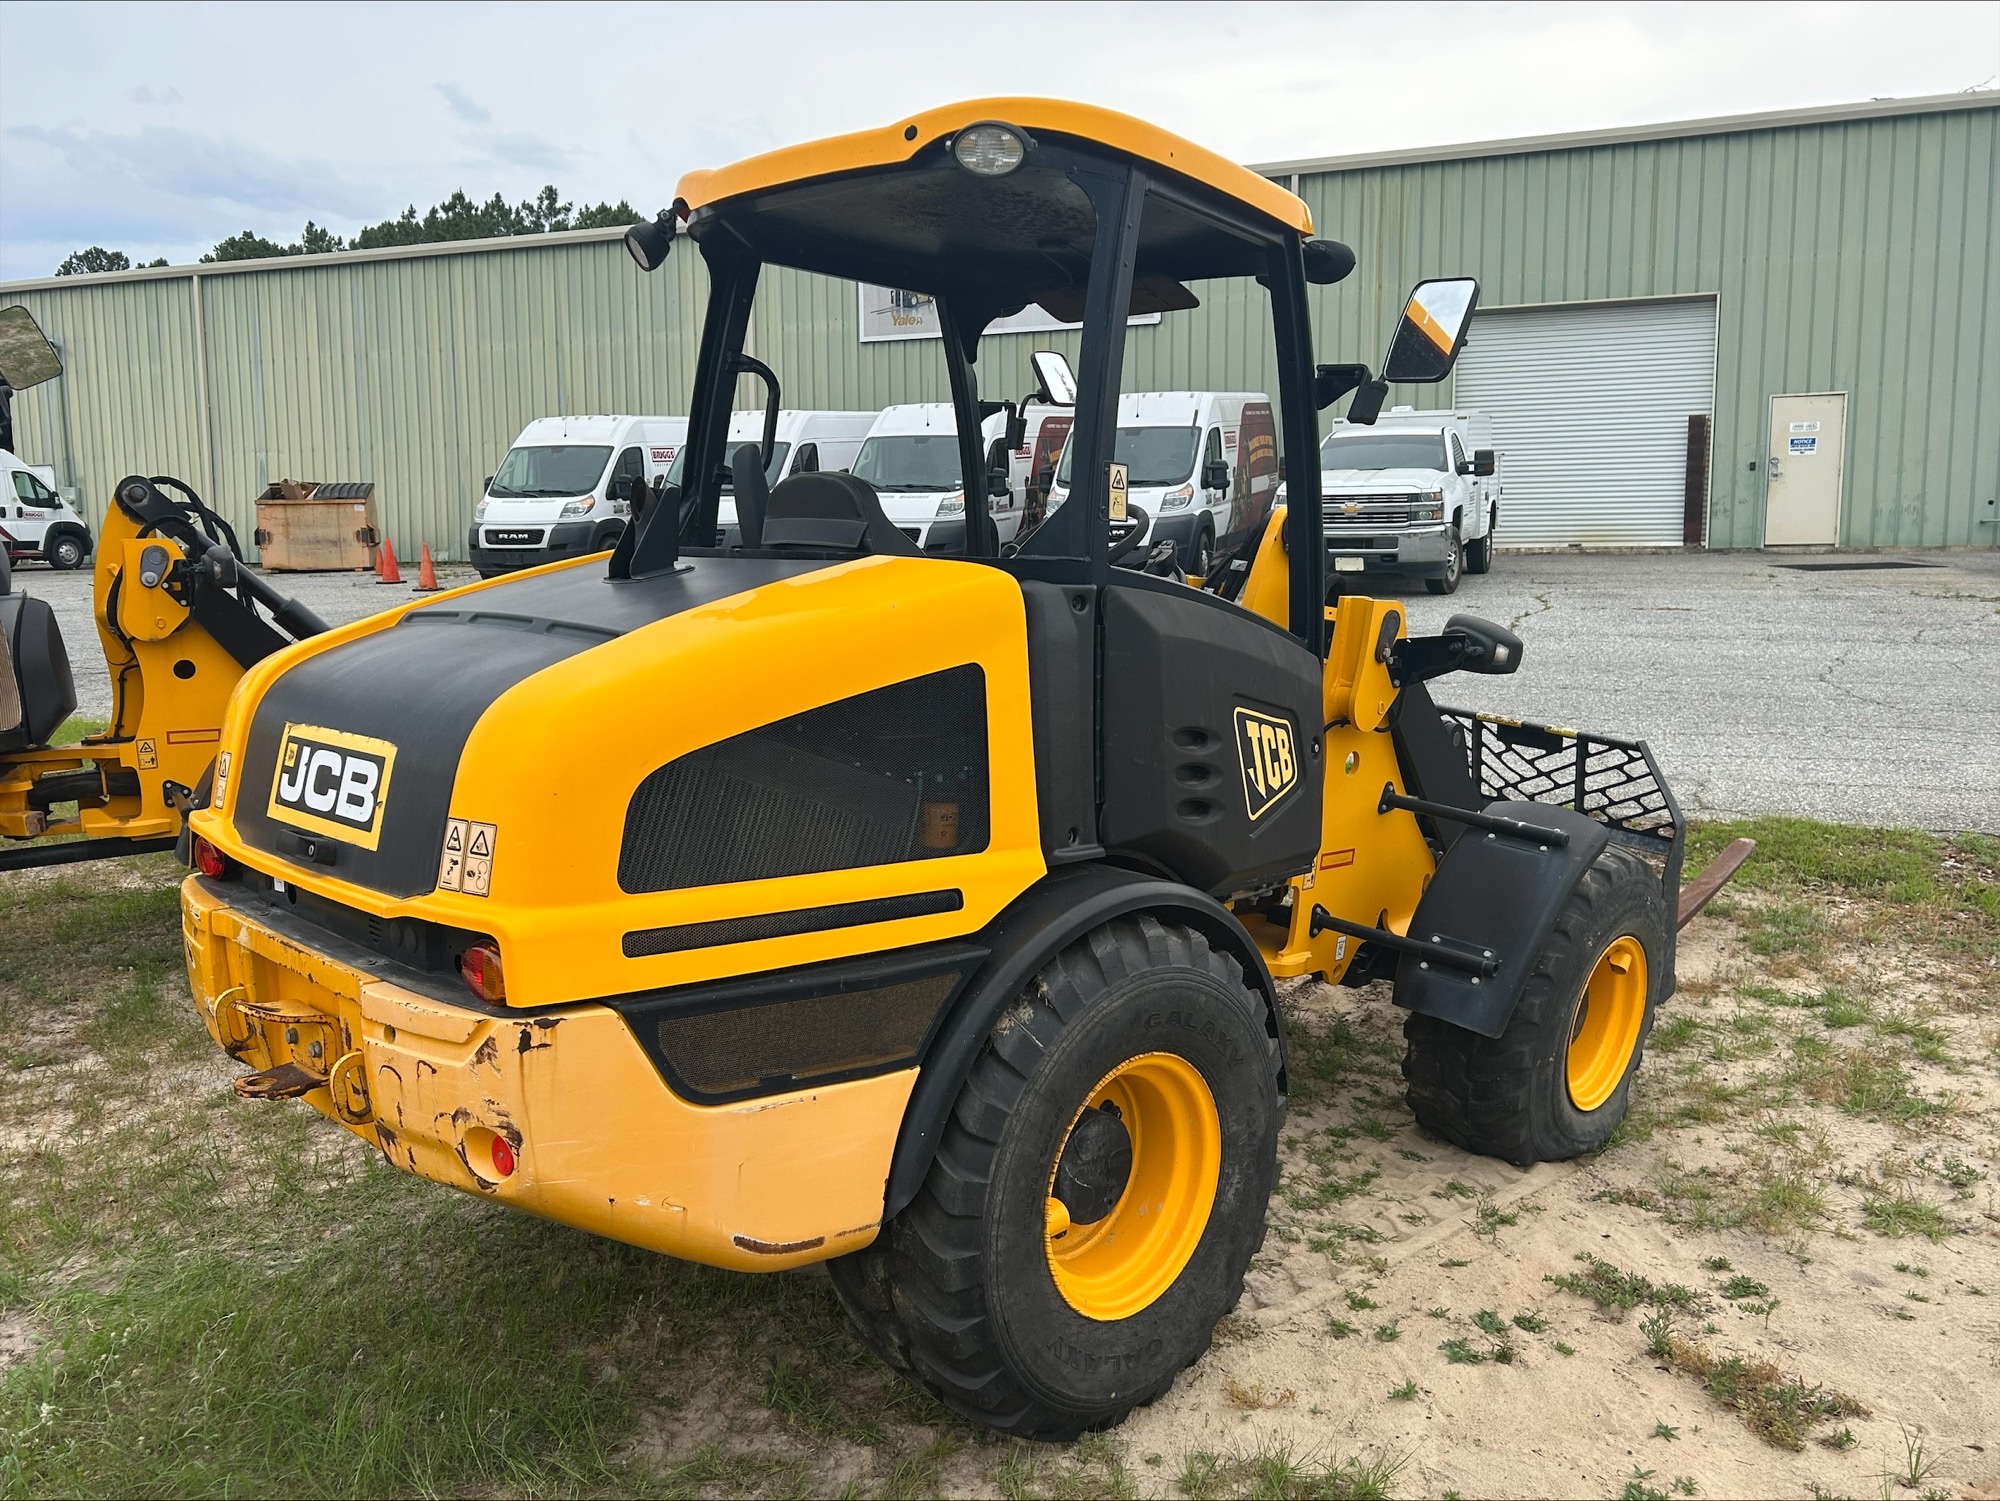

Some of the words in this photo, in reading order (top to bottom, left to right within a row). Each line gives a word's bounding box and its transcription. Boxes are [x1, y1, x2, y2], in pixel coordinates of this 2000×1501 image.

[892, 315, 917, 327] Yale
[652, 450, 675, 459] BRIGGS
[280, 745, 379, 823] JCB
[1245, 719, 1293, 799] JCB
[1143, 1009, 1245, 1069] GALAXY
